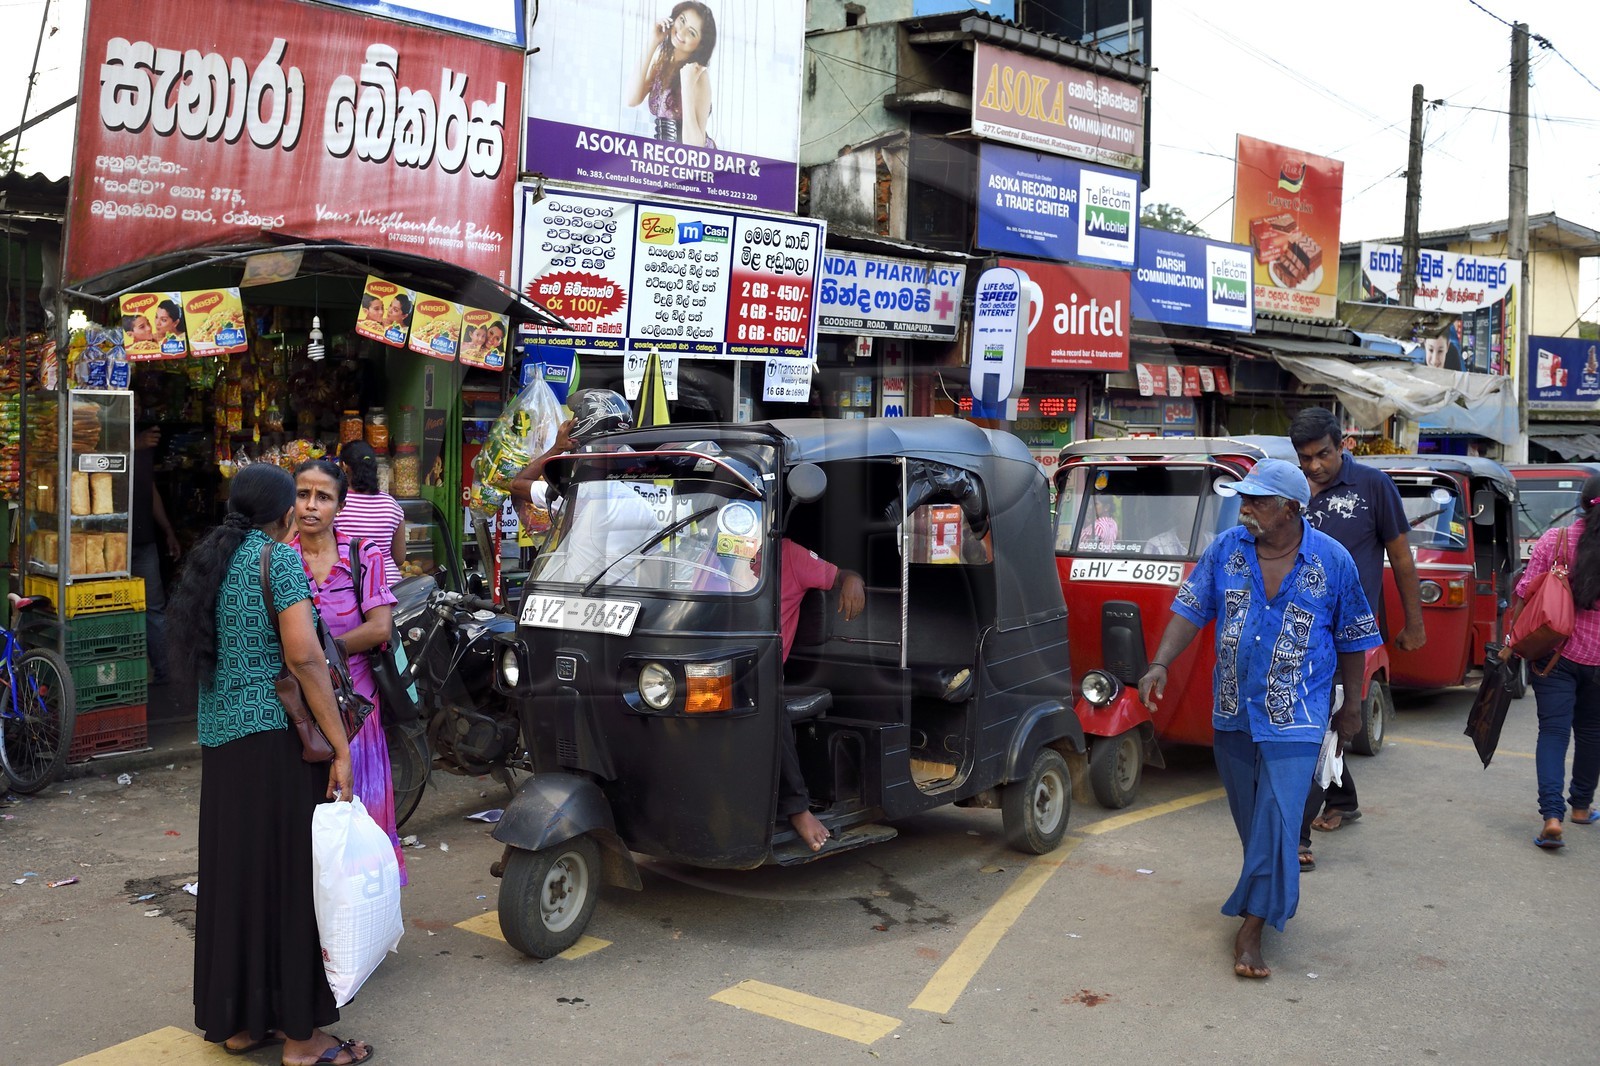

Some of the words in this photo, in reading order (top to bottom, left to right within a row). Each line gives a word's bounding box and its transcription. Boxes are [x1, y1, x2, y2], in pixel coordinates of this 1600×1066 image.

[980, 63, 1066, 126] ASOKA
[324, 44, 507, 180] බේකර්ස්
[1068, 114, 1134, 144] COMMUNICATION
[576, 131, 638, 158] ASOKA
[644, 142, 710, 169] RECORD
[714, 154, 745, 175] BAR
[749, 160, 760, 177] &
[631, 160, 669, 176] TRADE
[672, 166, 714, 184] CENTER
[577, 168, 588, 177] No.
[590, 170, 604, 180] 383,
[605, 171, 628, 183] Central
[630, 175, 642, 185] Bus
[643, 177, 663, 188] Stand,
[707, 187, 718, 195] Tel:
[718, 188, 730, 197] 045
[730, 190, 741, 198] 222
[746, 192, 758, 200] 220
[989, 174, 1020, 192] ASOKA
[1022, 180, 1058, 200] RECORD
[1060, 188, 1077, 203] BAR
[1101, 186, 1111, 194] Sri
[1112, 187, 1130, 198] Lanka
[996, 193, 1003, 206] &
[1005, 194, 1034, 212] TRADE
[1036, 204, 1069, 218] CENTER
[1086, 188, 1130, 210] Telecom
[1268, 191, 1291, 211] Layer
[548, 201, 614, 217] ඩයලොග්
[315, 204, 352, 222] Your
[356, 210, 461, 232] Neighbourhood
[465, 222, 504, 242] Baker
[653, 226, 674, 234] Cash
[1088, 210, 1127, 234] Mobitel
[683, 226, 699, 239] m
[704, 226, 727, 237] Cash
[745, 227, 781, 247] මෙමරි
[785, 232, 809, 250] කාඩ්
[542, 242, 616, 259] එයාර්ටෙල්
[648, 246, 685, 260] ඩයලොග්
[688, 249, 702, 262] බිල්
[704, 252, 718, 262] පත්
[551, 257, 576, 267] හච්
[582, 259, 605, 269] සිම්
[1156, 256, 1186, 273] DARSHI
[1212, 260, 1247, 279] Telecom
[1232, 260, 1247, 269] Lanka
[689, 266, 703, 278] බිල්
[705, 267, 720, 278] පත්
[865, 262, 960, 287] PHARMACY
[1137, 268, 1204, 289] COMMUNICATION
[1456, 258, 1506, 289] රත්නපුර
[369, 284, 394, 293] Maggi
[686, 280, 700, 293] බිල්
[702, 282, 716, 292] පත්
[742, 282, 750, 297] 2
[752, 282, 768, 298] GB
[777, 286, 808, 302] 450/-
[1214, 281, 1244, 301] Mobitel
[126, 297, 155, 310] Maggi
[190, 295, 223, 311] Maggi
[676, 295, 690, 308] බිල්
[692, 297, 706, 307] පත්
[980, 291, 1018, 301] SPEED
[420, 304, 446, 312] Maggi
[570, 298, 608, 314] 100/-
[740, 303, 748, 318] 4
[750, 304, 766, 319] GB
[775, 307, 807, 322] 550/-
[979, 309, 1015, 317] INTERNET
[1053, 292, 1123, 337] airtel
[655, 310, 669, 322] ජල
[672, 310, 686, 323] බිල්
[688, 312, 702, 322] පත්
[824, 318, 863, 328] GOODSHED
[866, 321, 888, 330] ROAD,
[894, 322, 934, 332] RATNAPURA.
[738, 324, 746, 339] 8
[748, 326, 764, 340] GB
[774, 327, 805, 342] 650/-
[547, 367, 566, 376] Cash
[778, 364, 809, 375] Transcend
[767, 387, 774, 396] 16
[775, 387, 785, 396] GB
[1088, 561, 1112, 578] HV
[1133, 564, 1181, 582] 6895
[539, 599, 566, 624] YZ
[581, 602, 634, 630] 9667
